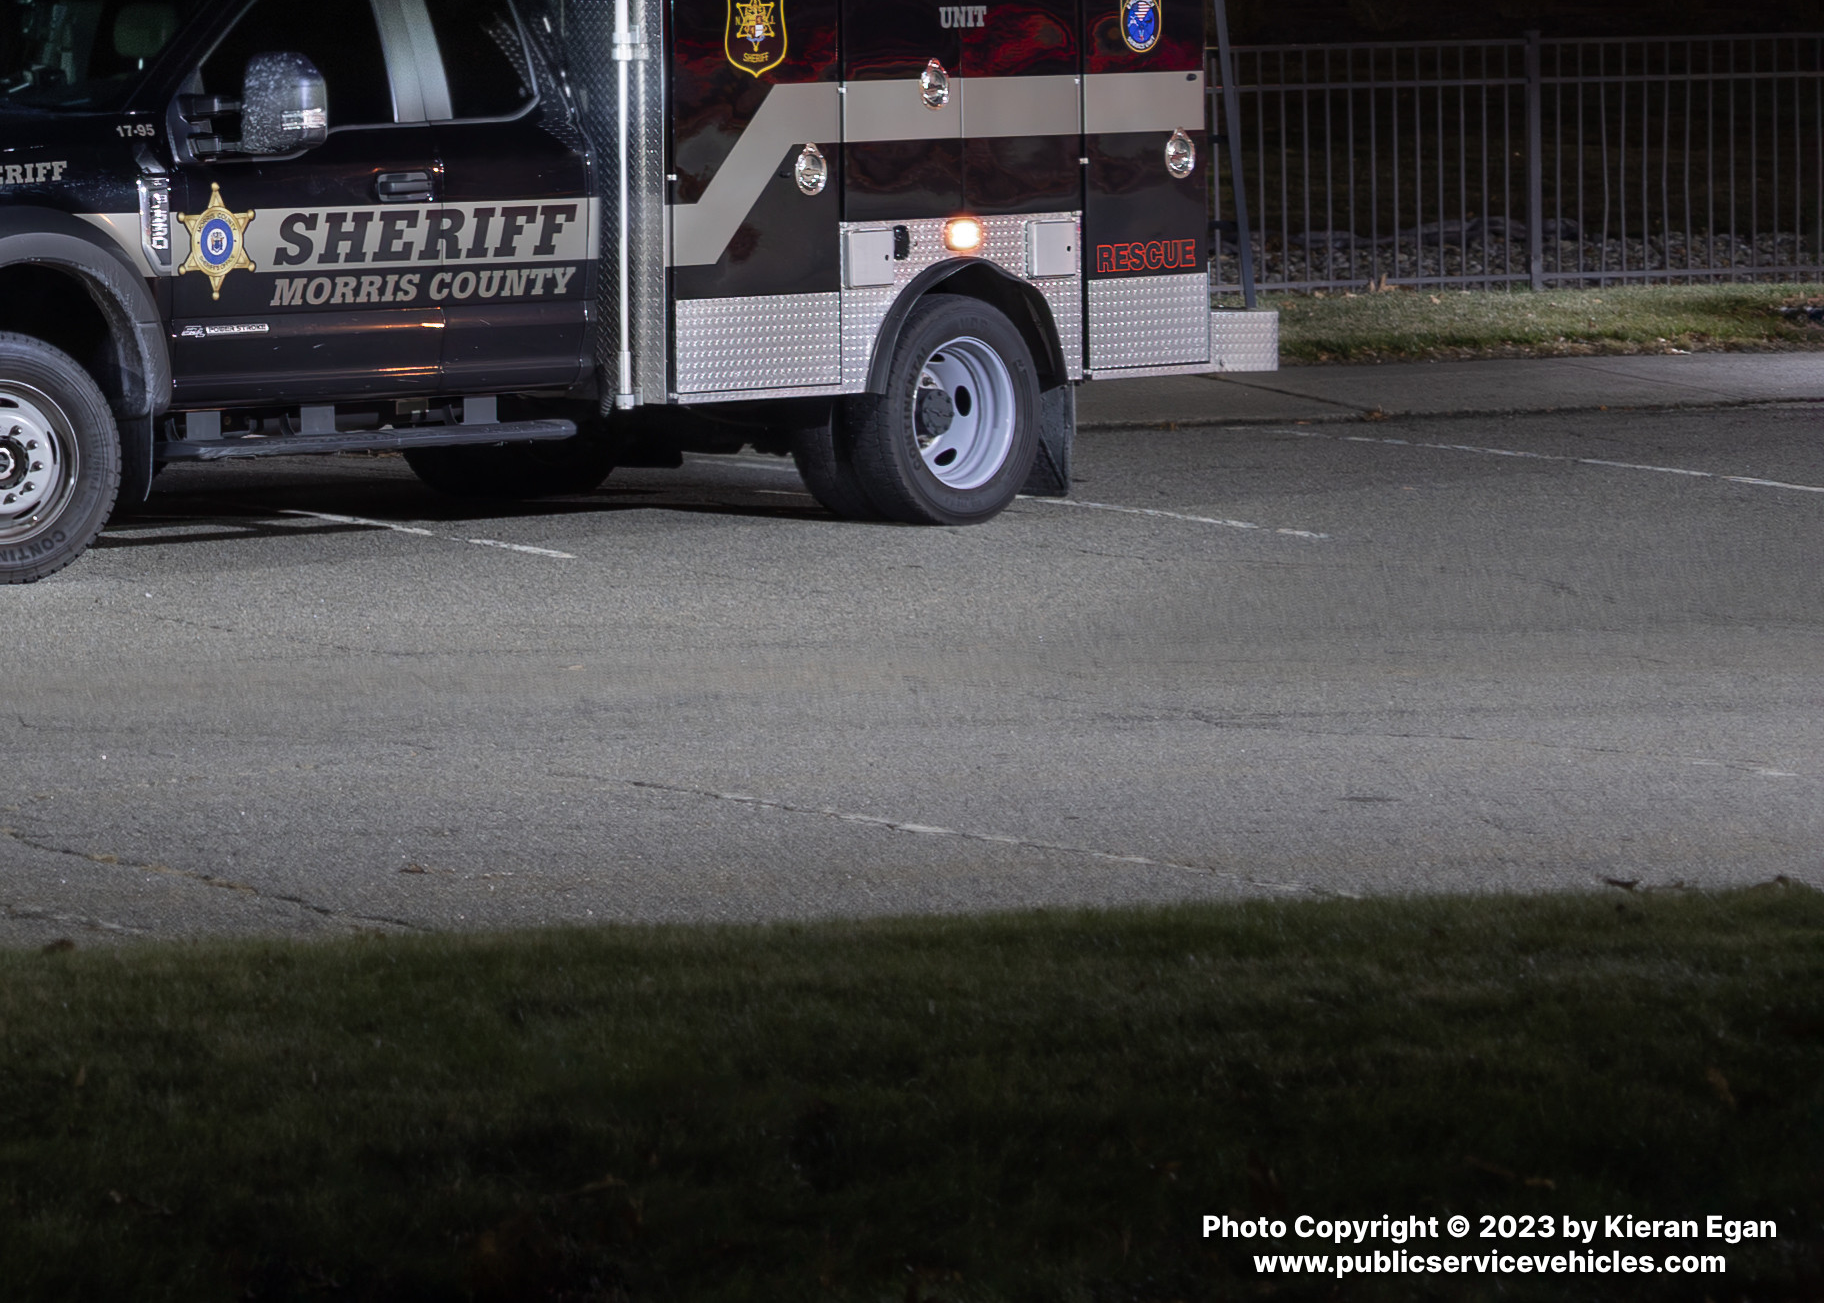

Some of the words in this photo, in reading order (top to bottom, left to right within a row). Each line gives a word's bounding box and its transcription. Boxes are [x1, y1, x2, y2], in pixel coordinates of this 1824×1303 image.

[938, 5, 987, 29] UNIT
[115, 124, 156, 137] 17-95
[217, 212, 237, 232] COUNTY
[274, 203, 577, 267] SHERIFF
[1097, 239, 1196, 273] RESCUE
[269, 275, 421, 307] MORRIS
[427, 267, 577, 301] COUNTY
